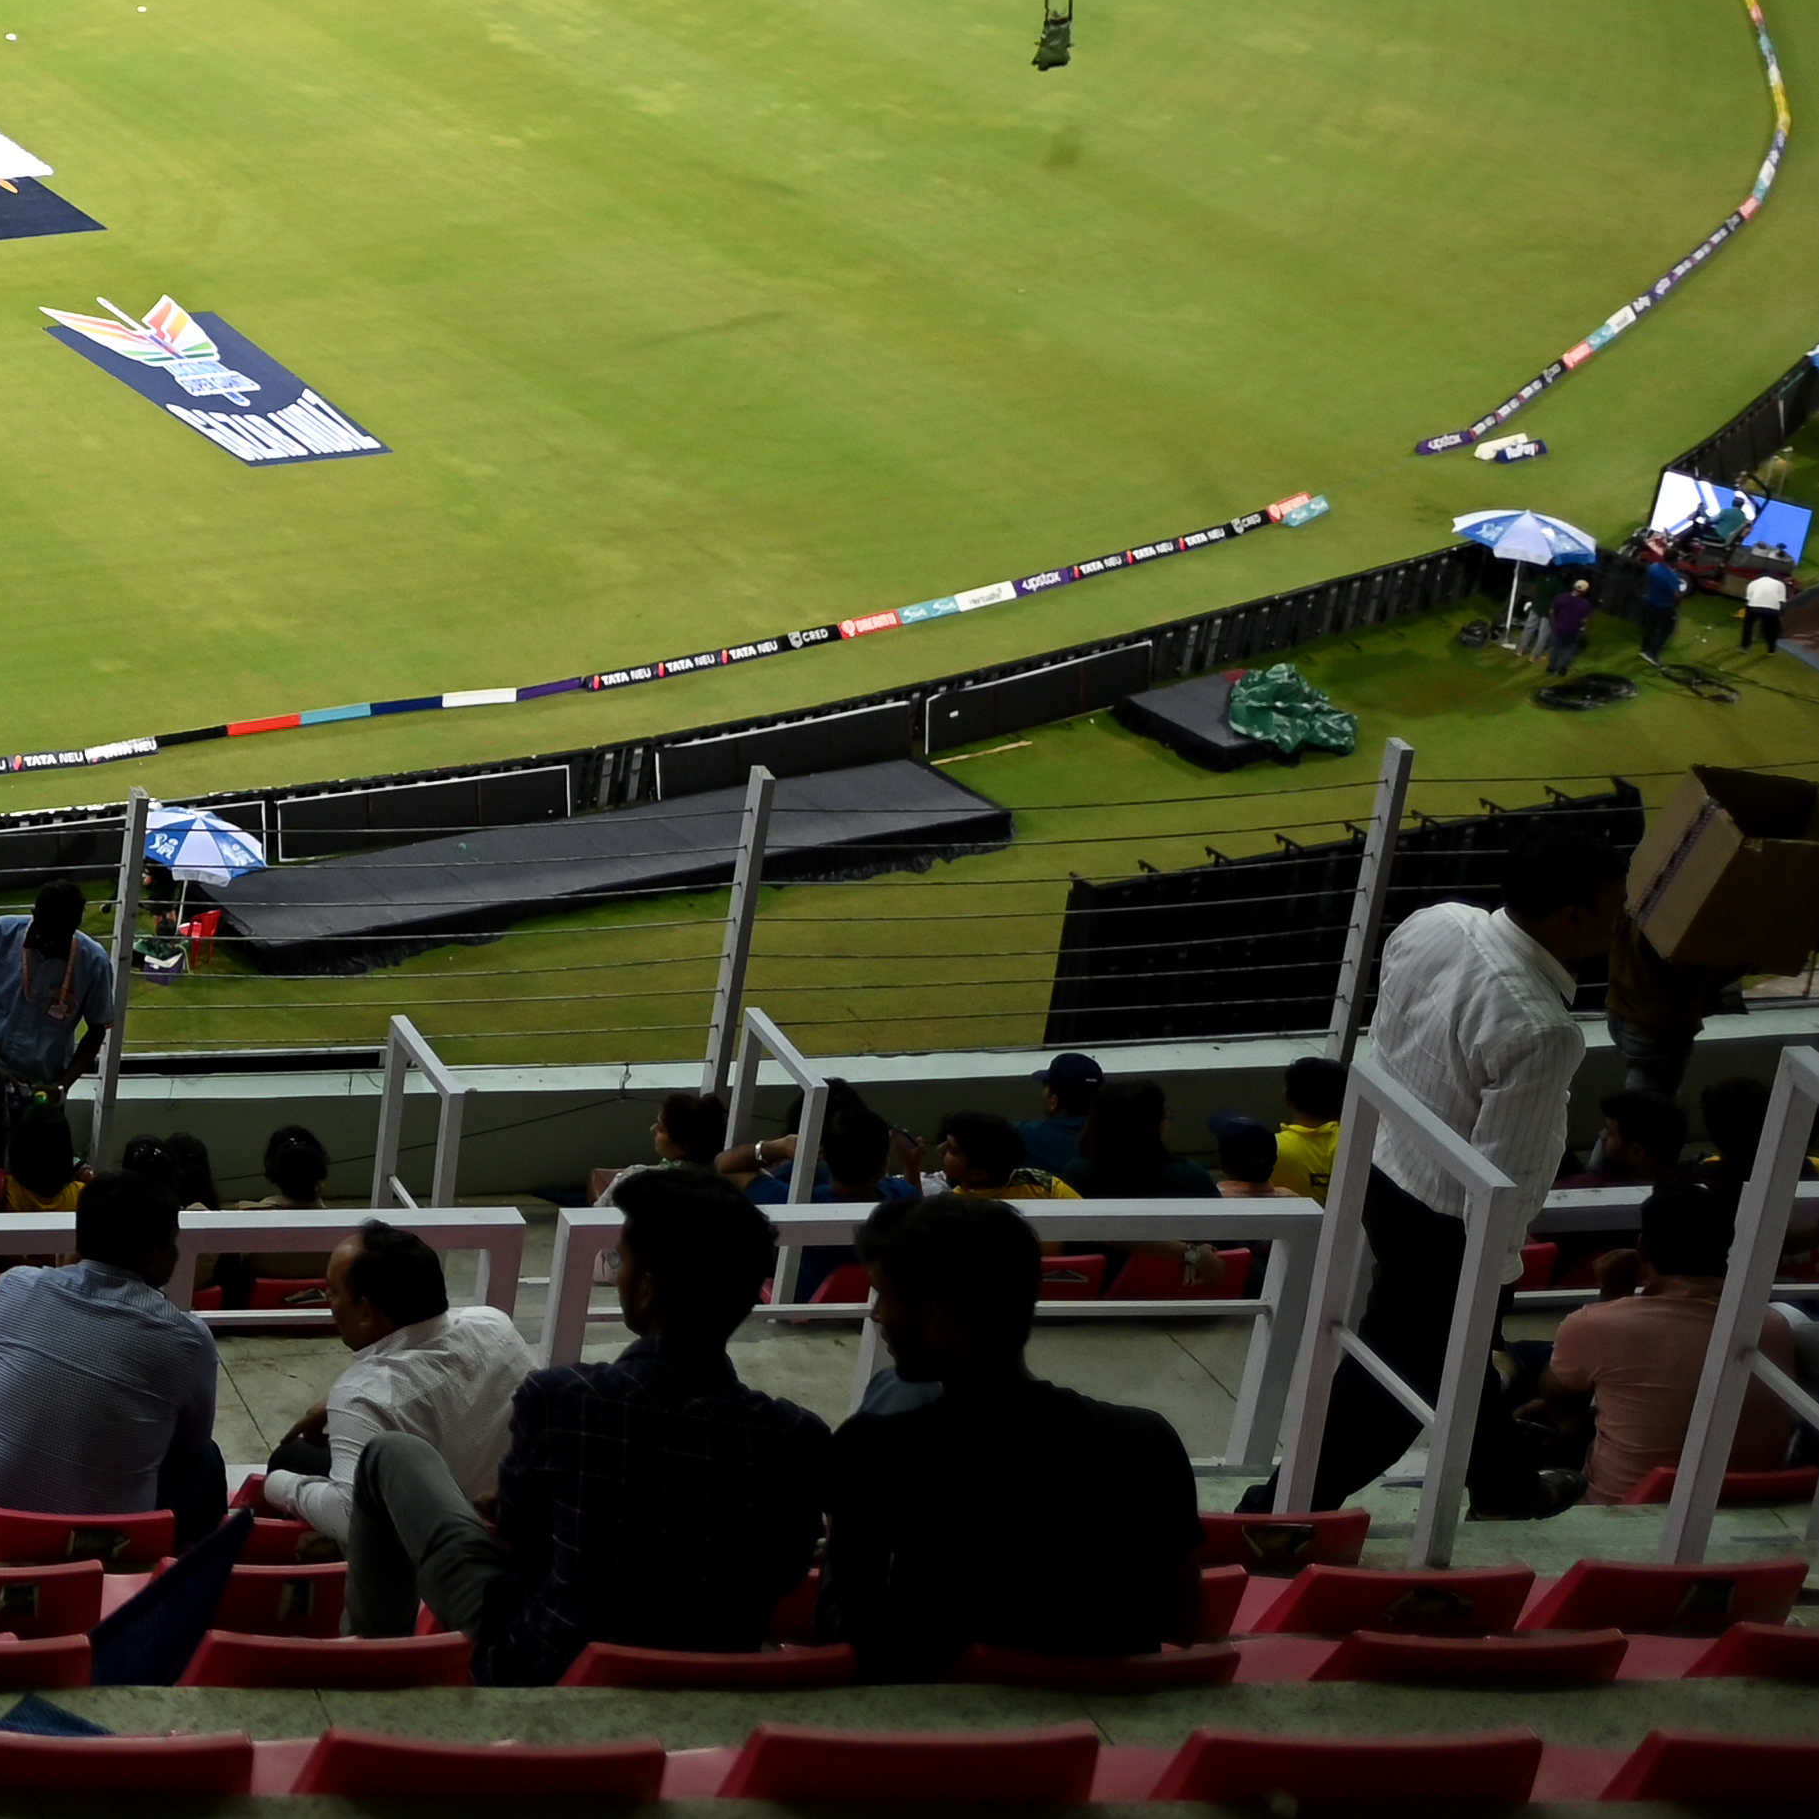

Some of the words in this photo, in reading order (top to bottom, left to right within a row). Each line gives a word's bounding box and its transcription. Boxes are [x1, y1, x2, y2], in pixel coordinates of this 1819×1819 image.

[1185, 532, 1208, 548] TATA
[1133, 546, 1156, 562] TATA
[1080, 561, 1104, 576] TATA
[1021, 570, 1062, 593] upstox
[802, 628, 829, 643] CRED
[729, 646, 757, 660] TATA
[758, 641, 779, 654] NEU
[665, 659, 693, 673] TATA
[694, 654, 715, 668] NEU
[601, 671, 629, 686] TATA
[630, 667, 652, 681] NEU
[24, 755, 56, 767] TATA
[59, 751, 84, 764] NEU
